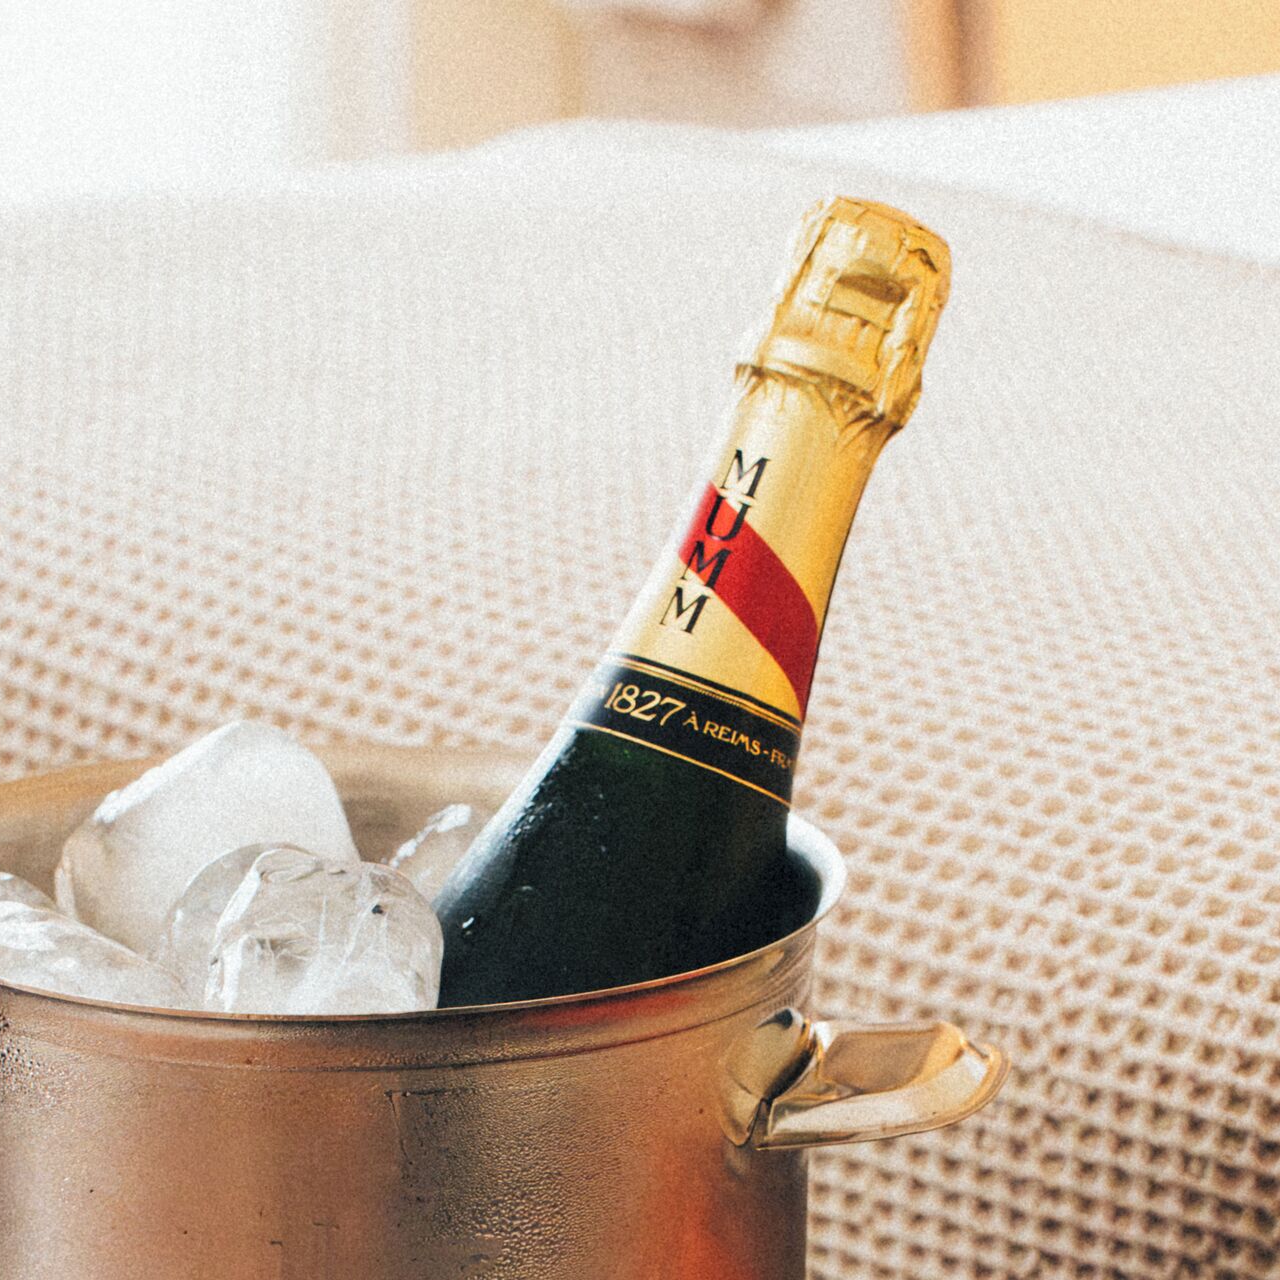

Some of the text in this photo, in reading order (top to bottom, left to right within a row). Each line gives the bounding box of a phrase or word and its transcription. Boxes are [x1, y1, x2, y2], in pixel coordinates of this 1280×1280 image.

[659, 448, 770, 635] MUMM
[603, 682, 687, 726] 1827
[703, 720, 761, 757] REIMS
